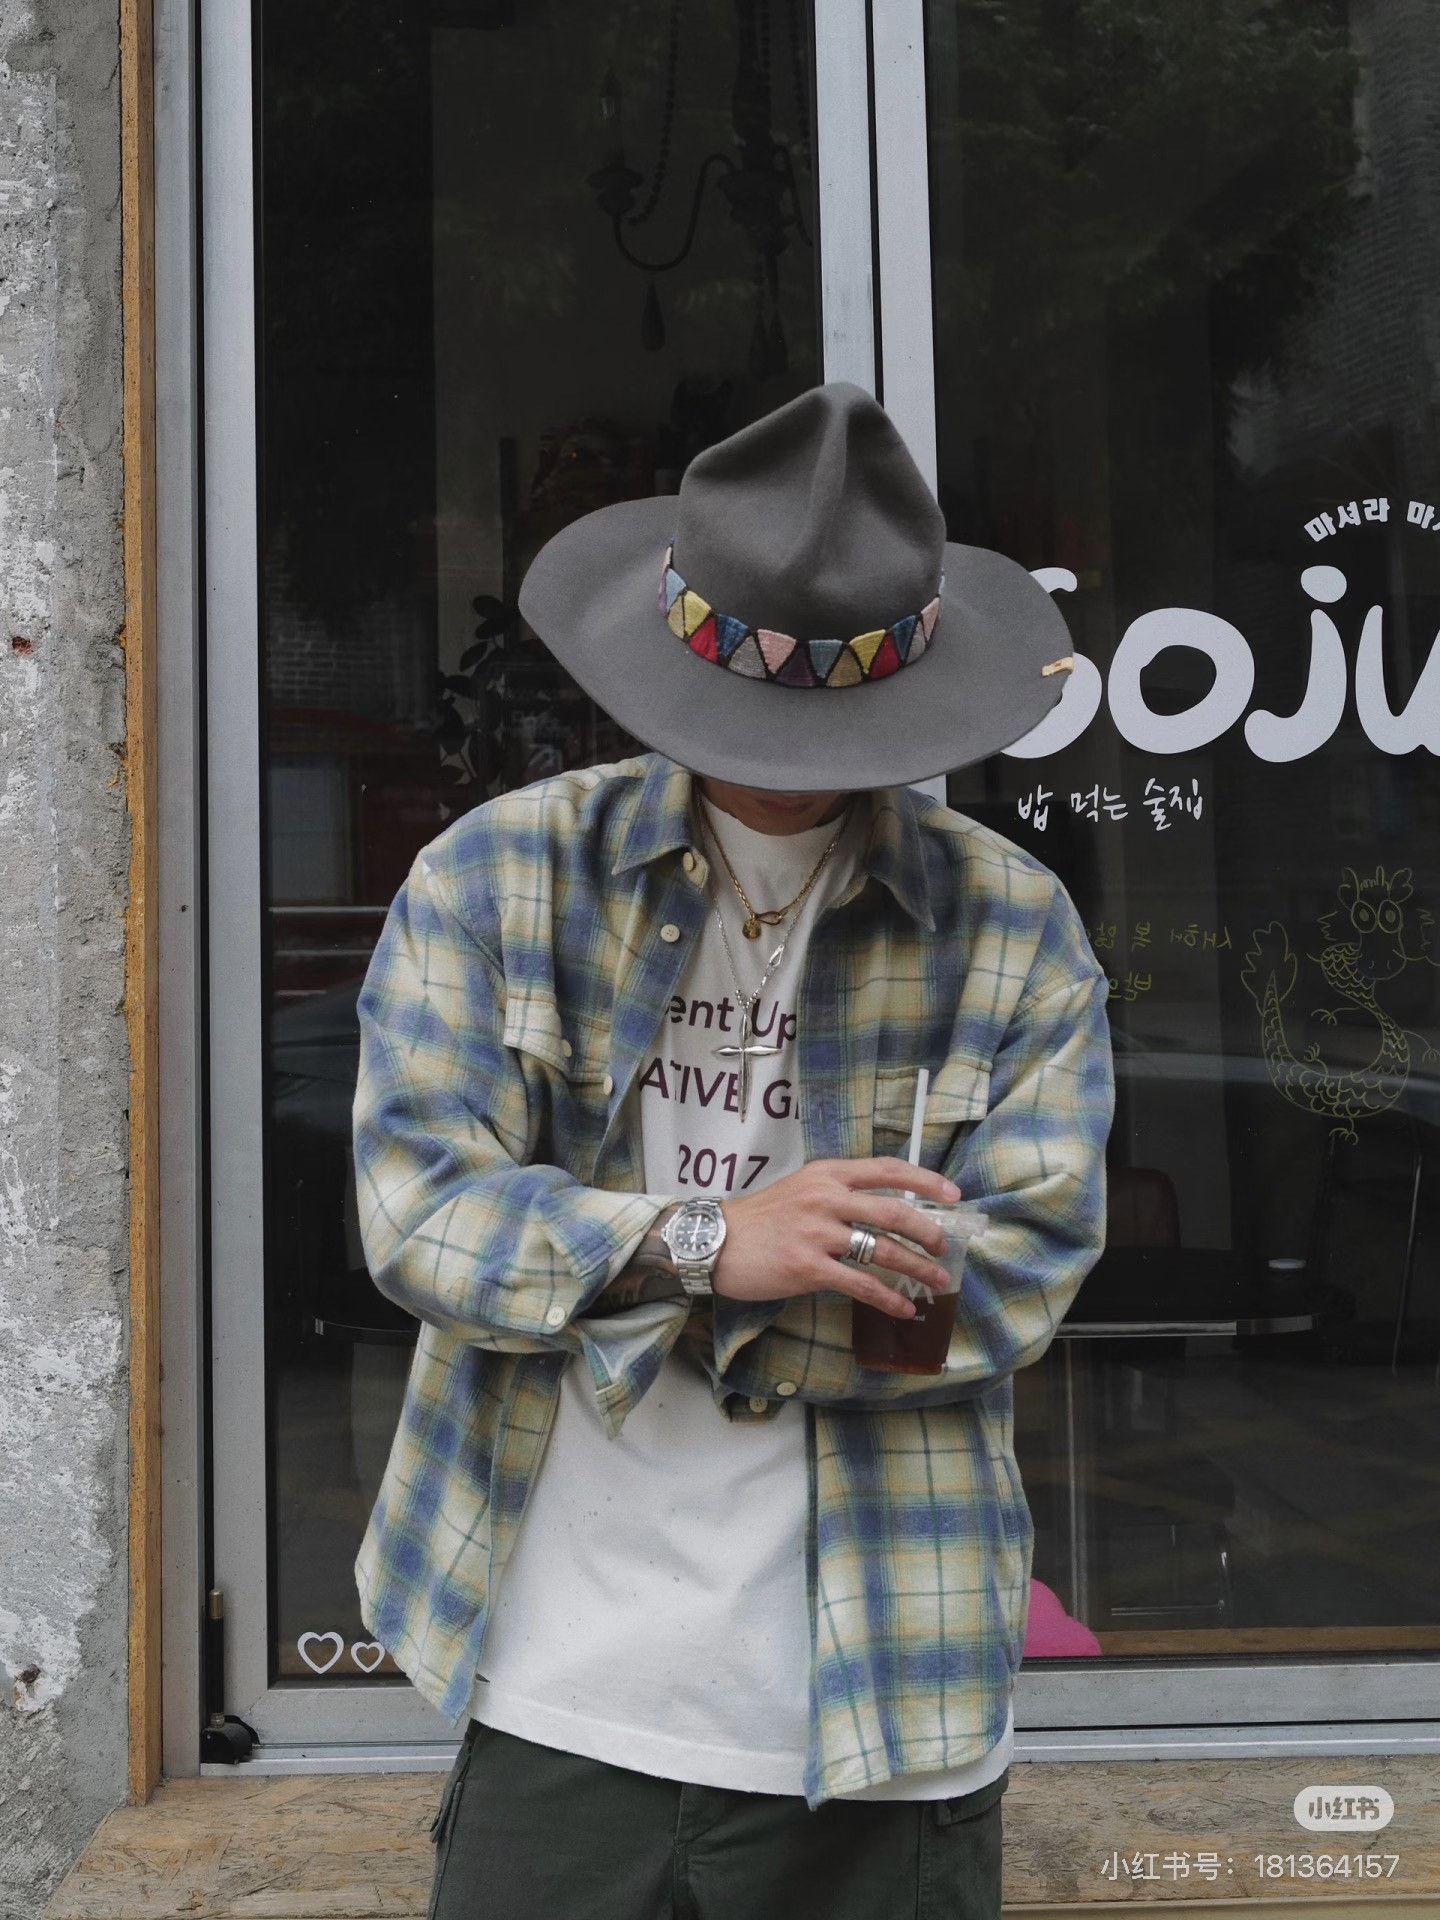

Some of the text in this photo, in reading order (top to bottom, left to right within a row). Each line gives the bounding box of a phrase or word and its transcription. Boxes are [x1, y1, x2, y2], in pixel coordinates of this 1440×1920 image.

[1304, 498, 1440, 542] 마셔라 마
[1017, 777, 1204, 832] 밥 먹는 술집
[664, 994, 735, 1032] ent
[762, 1079, 800, 1120] G
[678, 1144, 770, 1192] 2017
